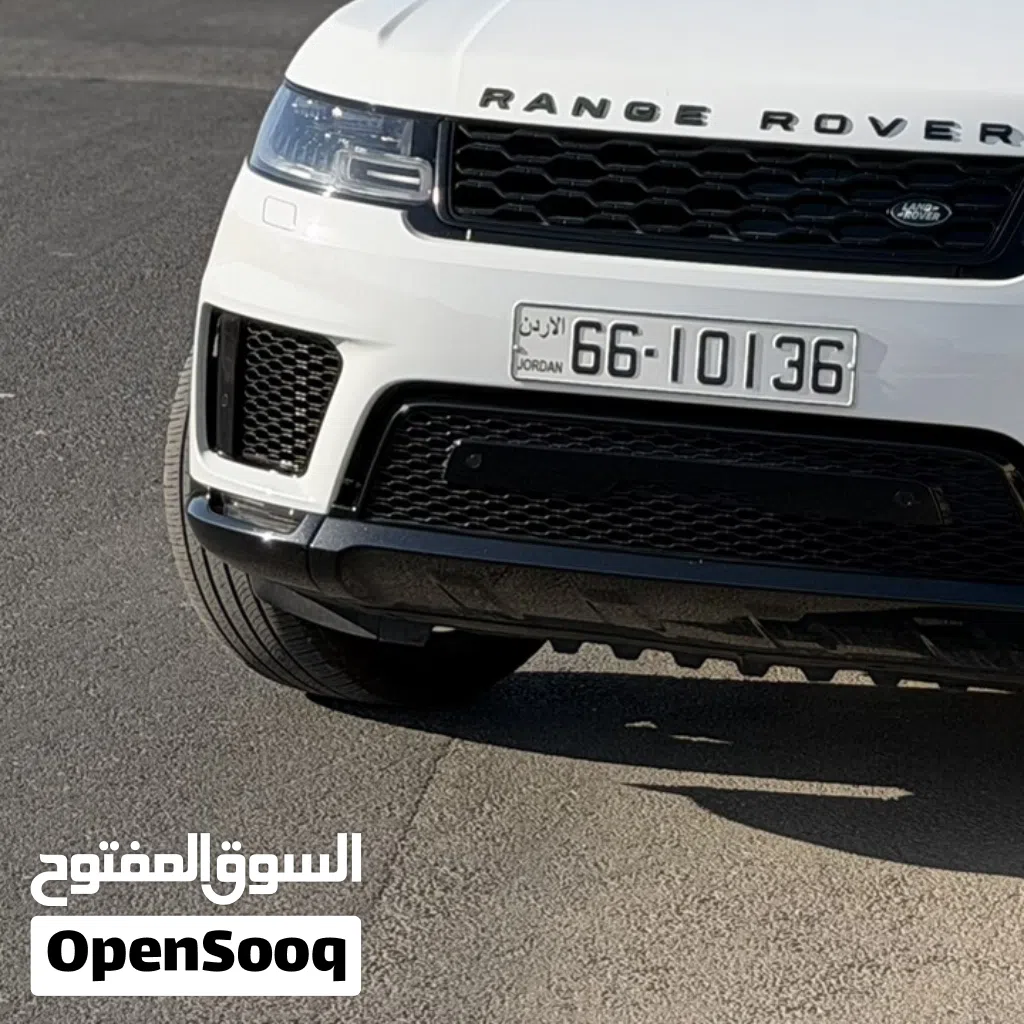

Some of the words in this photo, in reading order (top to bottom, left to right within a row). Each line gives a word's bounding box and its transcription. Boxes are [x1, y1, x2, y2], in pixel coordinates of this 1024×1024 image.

[479, 87, 712, 128] RANGE
[759, 110, 1023, 147] ROVER
[516, 357, 564, 374] JORDAN
[571, 319, 845, 395] 66-10136
